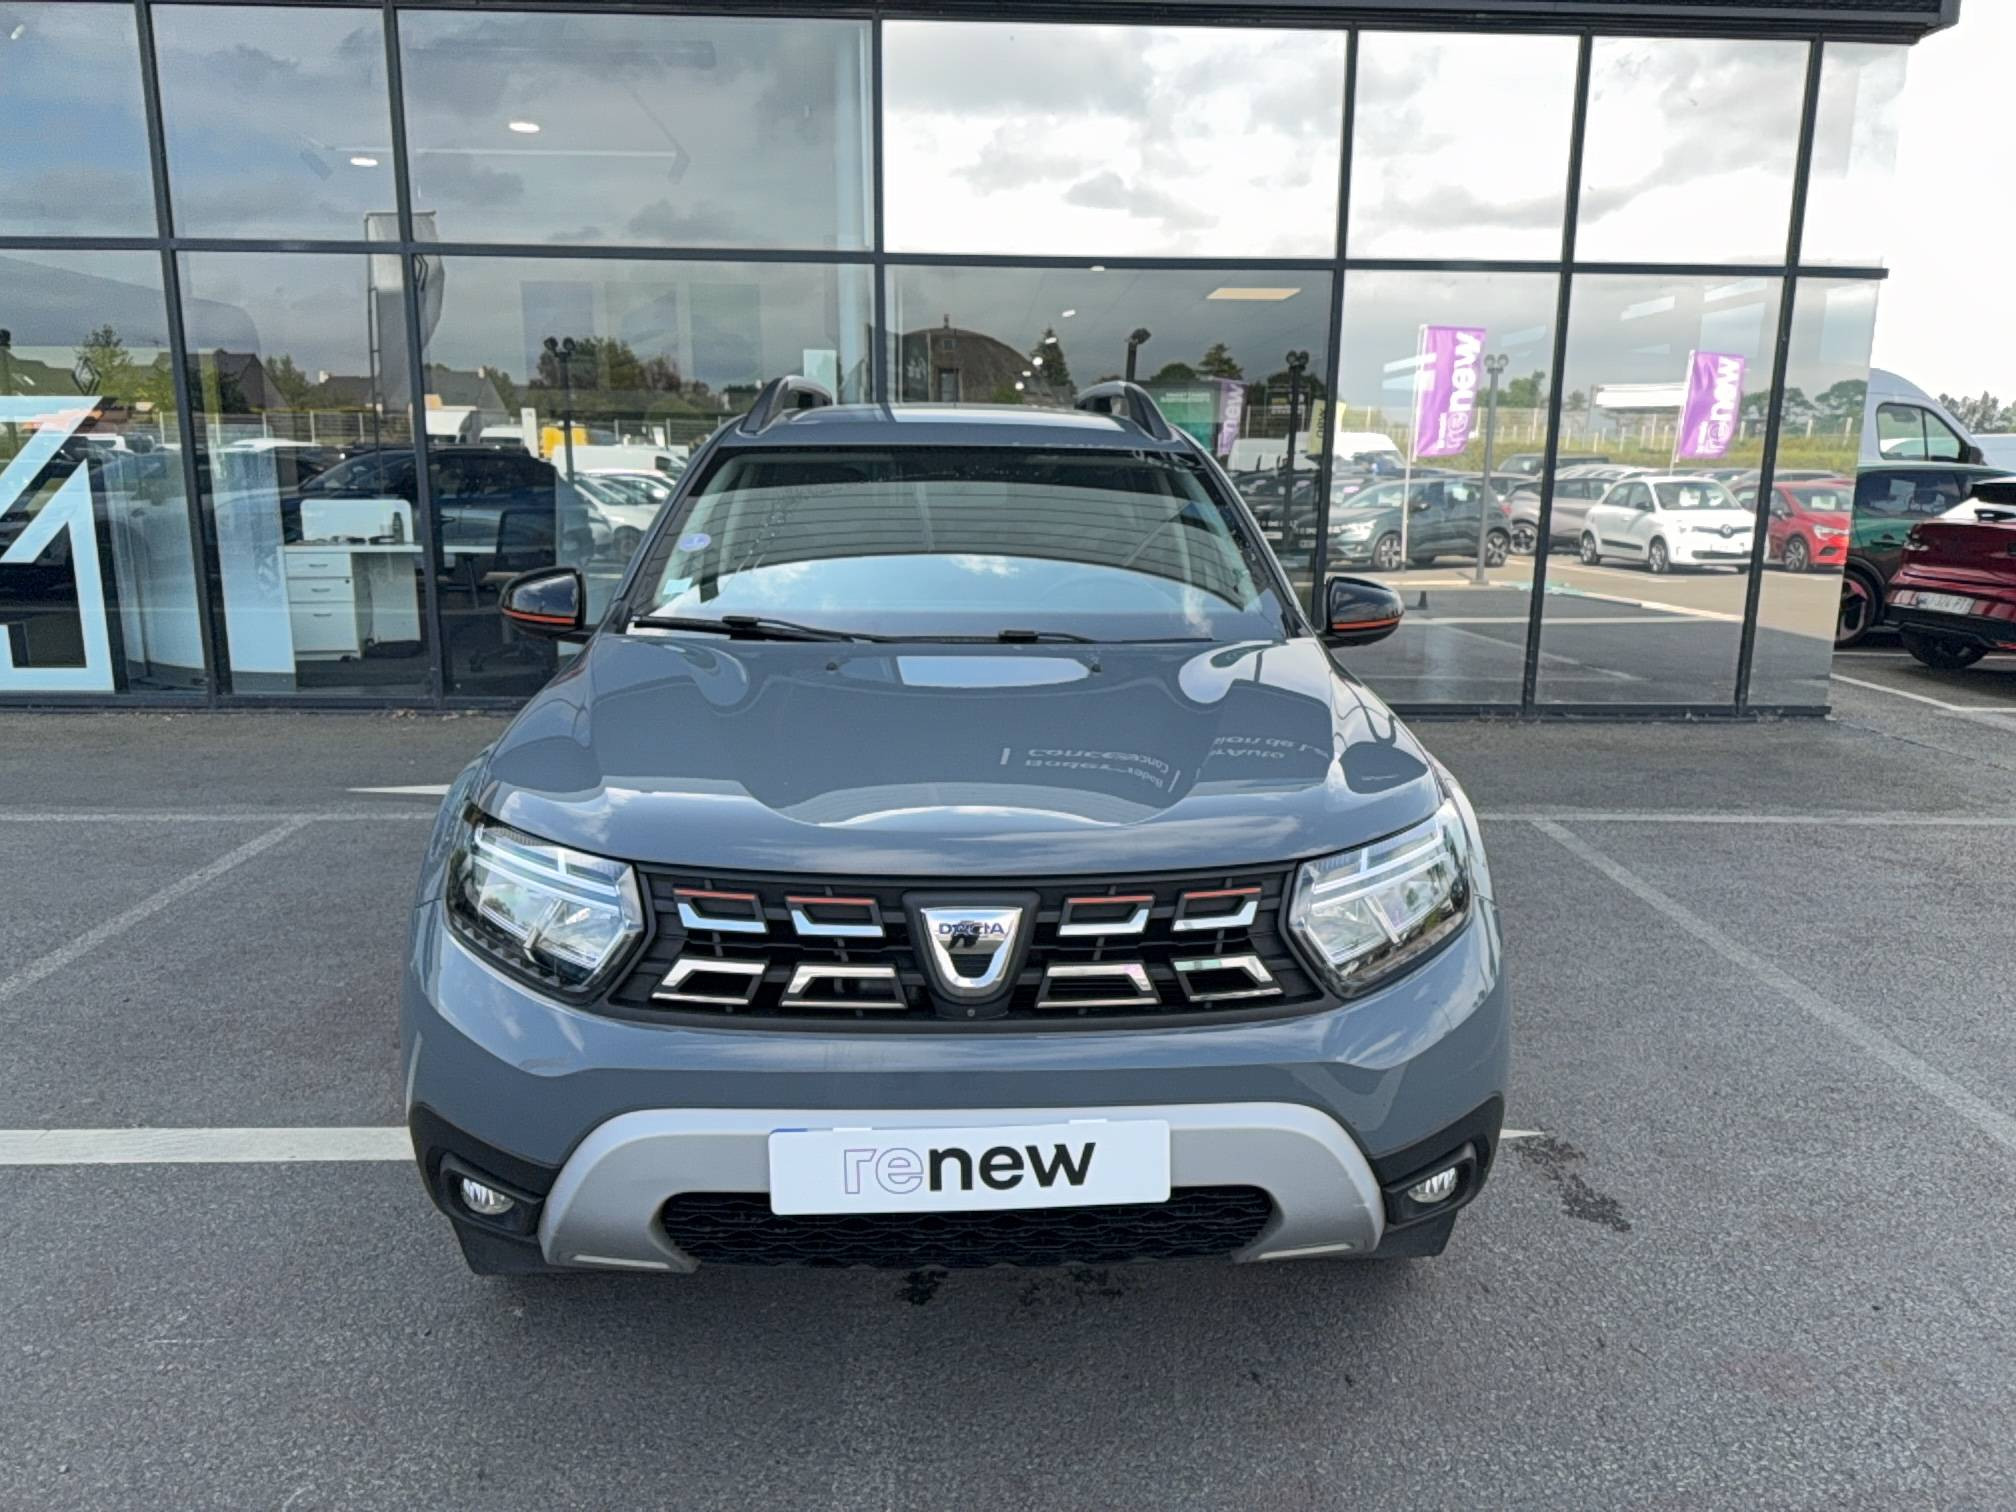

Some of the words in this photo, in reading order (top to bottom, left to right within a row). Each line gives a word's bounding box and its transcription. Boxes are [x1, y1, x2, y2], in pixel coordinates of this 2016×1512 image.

[1446, 332, 1481, 448] renew
[1704, 356, 1740, 453] renew
[843, 1142, 1096, 1195] renew
